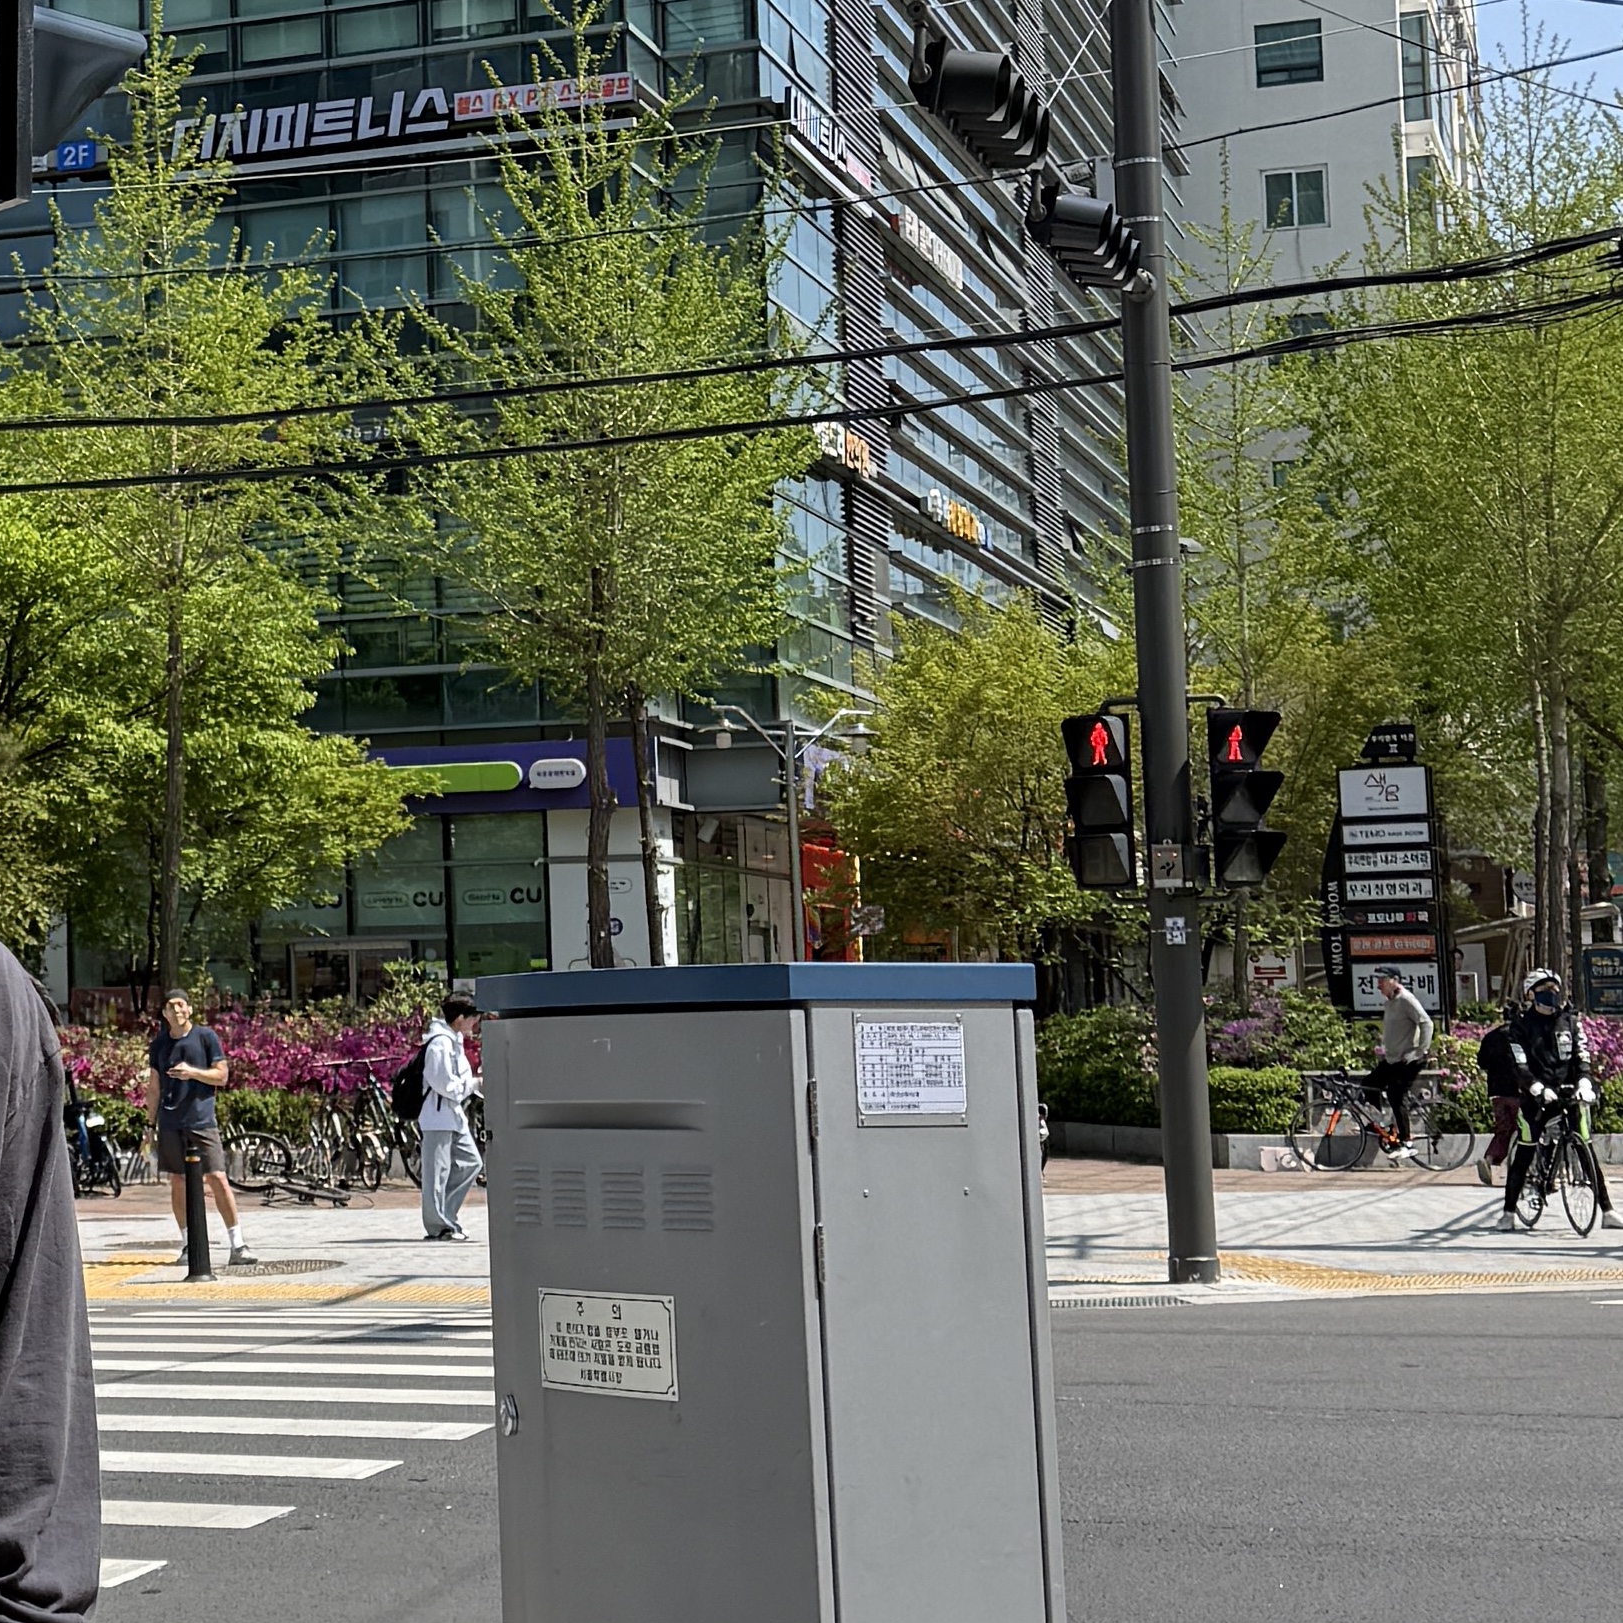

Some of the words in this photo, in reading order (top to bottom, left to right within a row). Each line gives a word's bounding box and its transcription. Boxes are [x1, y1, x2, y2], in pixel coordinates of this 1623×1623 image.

[62, 146, 89, 168] 2F
[412, 891, 443, 907] CU
[509, 887, 542, 904] CU
[1330, 933, 1343, 975] TOWN
